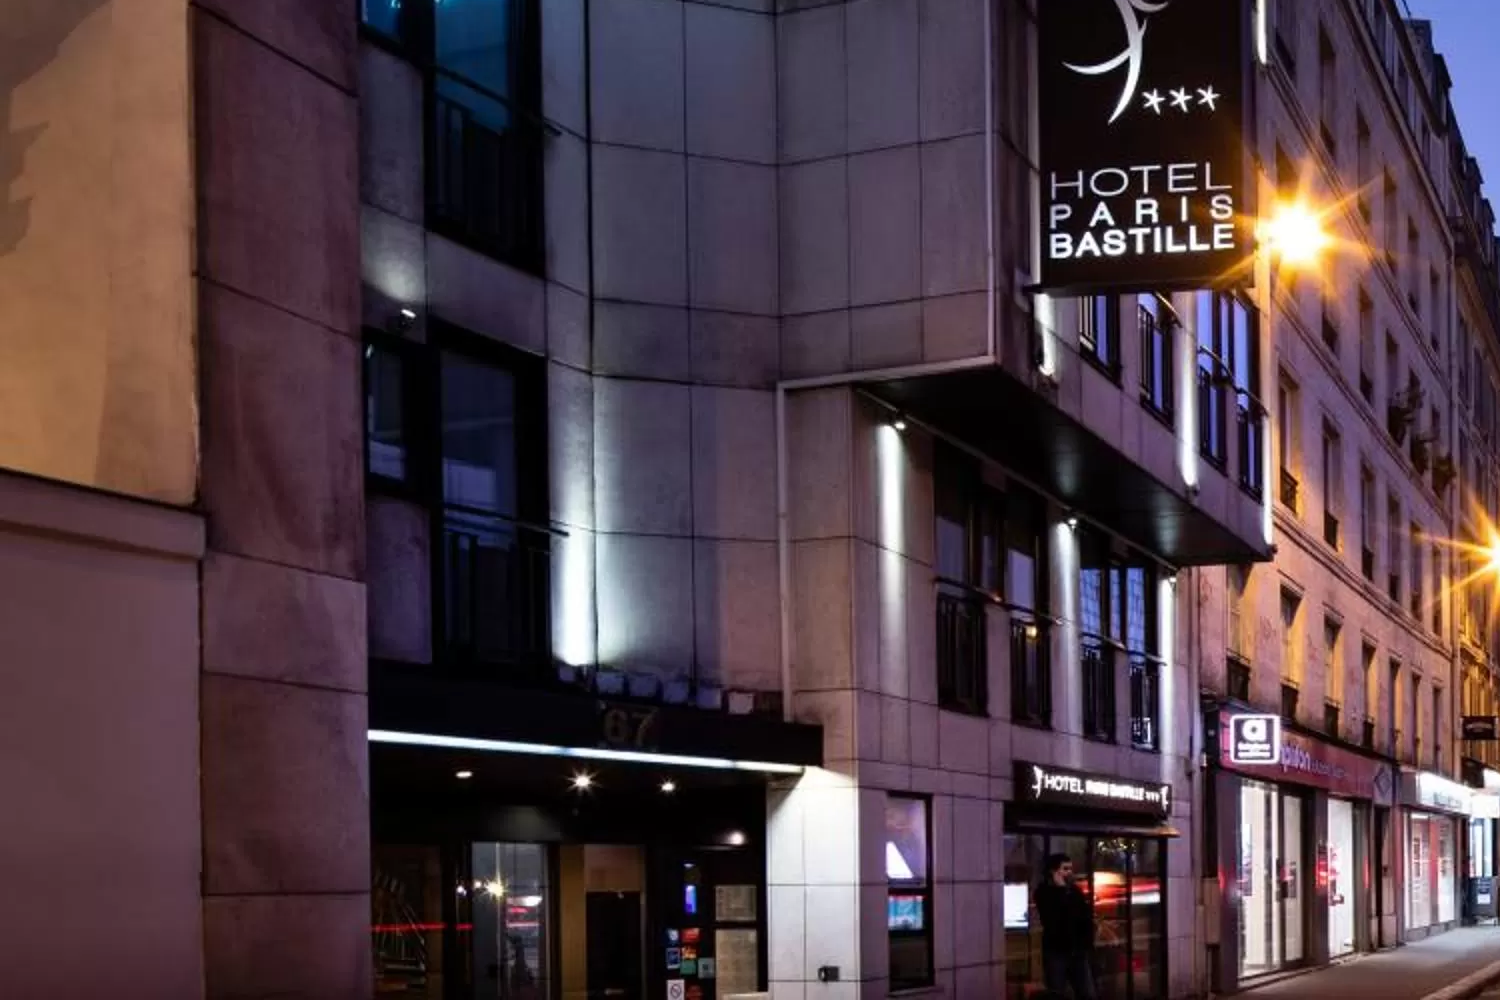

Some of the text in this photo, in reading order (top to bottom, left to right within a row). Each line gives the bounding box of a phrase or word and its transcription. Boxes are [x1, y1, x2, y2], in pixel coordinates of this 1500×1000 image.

[1050, 162, 1233, 200] HOTEL
[1050, 194, 1233, 230] PARIS
[1050, 223, 1235, 259] BASTILLE
[1044, 774, 1084, 794] HOTEL
